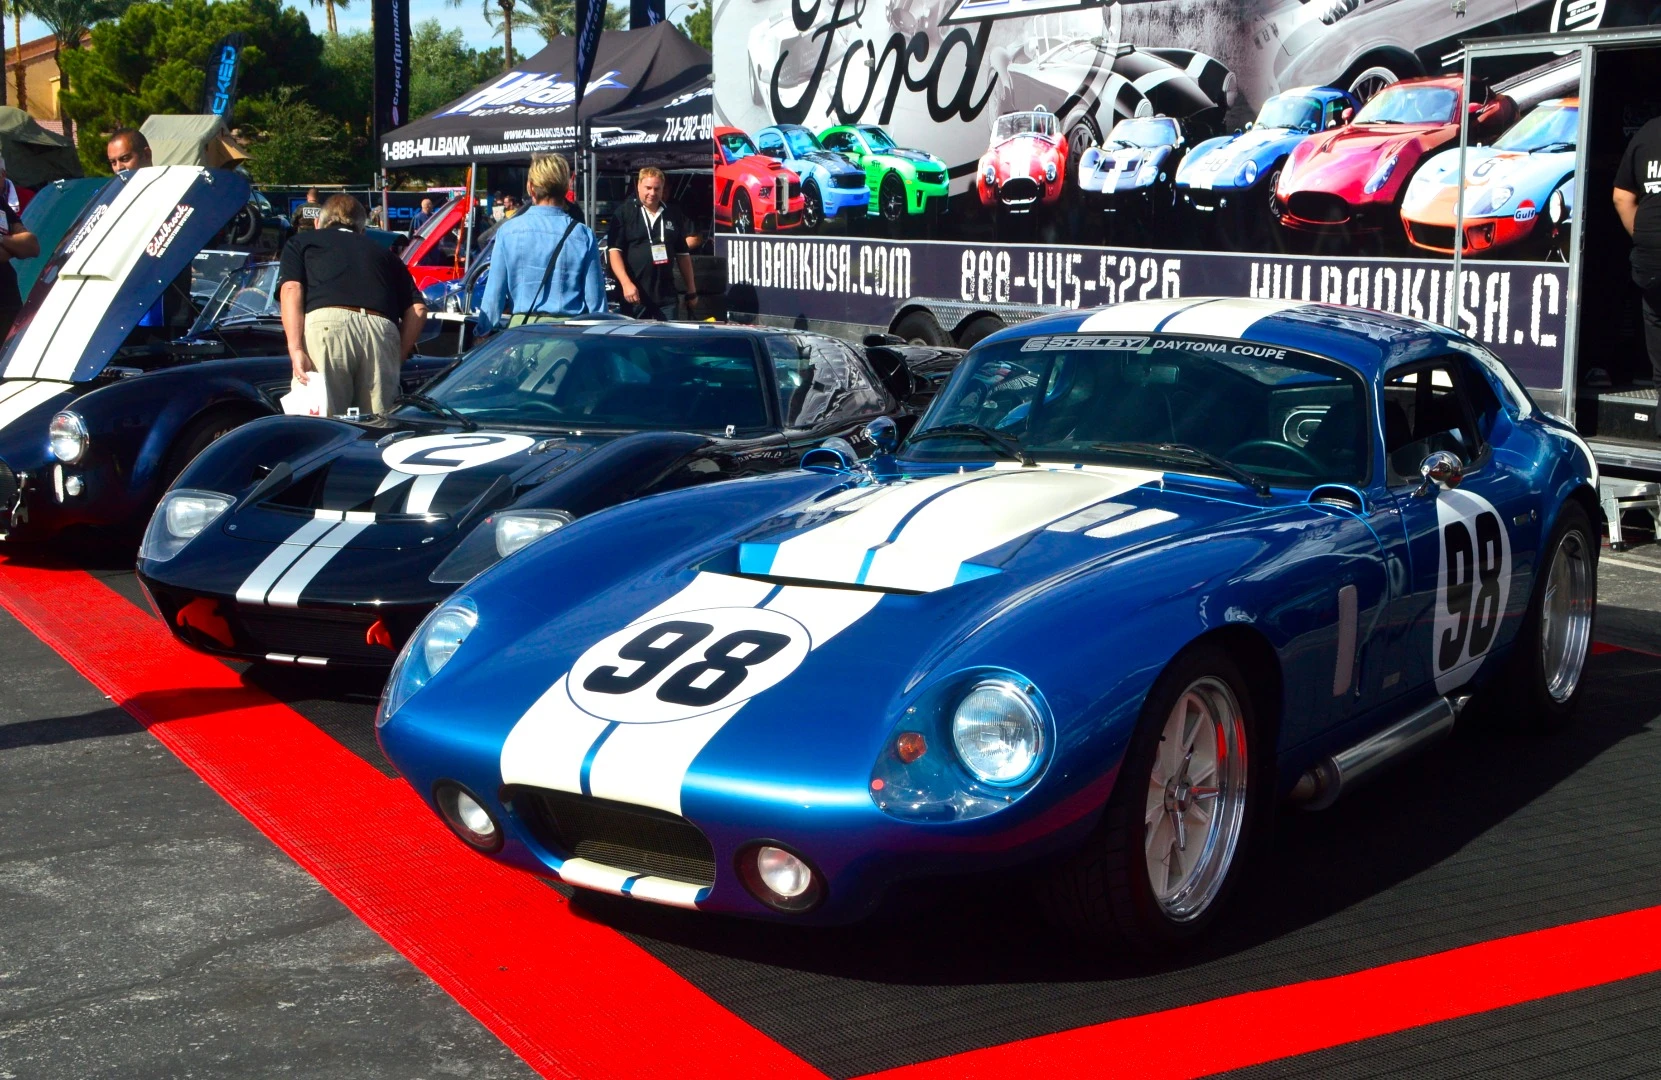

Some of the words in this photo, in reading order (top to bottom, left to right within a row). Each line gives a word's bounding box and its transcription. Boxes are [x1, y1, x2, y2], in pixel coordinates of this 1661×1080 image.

[213, 46, 236, 117] CKED
[770, 0, 999, 125] Ford
[383, 136, 470, 161] 1-888-HILLBANK
[145, 203, 189, 257] Edelbrock
[1515, 210, 1535, 220] Gulf
[727, 240, 912, 298] HILLBANKUSA.COM
[961, 249, 1182, 310] 888-445-5226
[1249, 262, 1568, 348] HILLBANKUSA.C
[1044, 336, 1146, 349] SHELBY
[1152, 339, 1227, 354] DAYTONA
[1231, 344, 1287, 360] COUPE
[1438, 511, 1503, 672] 98
[583, 620, 792, 707] 98
